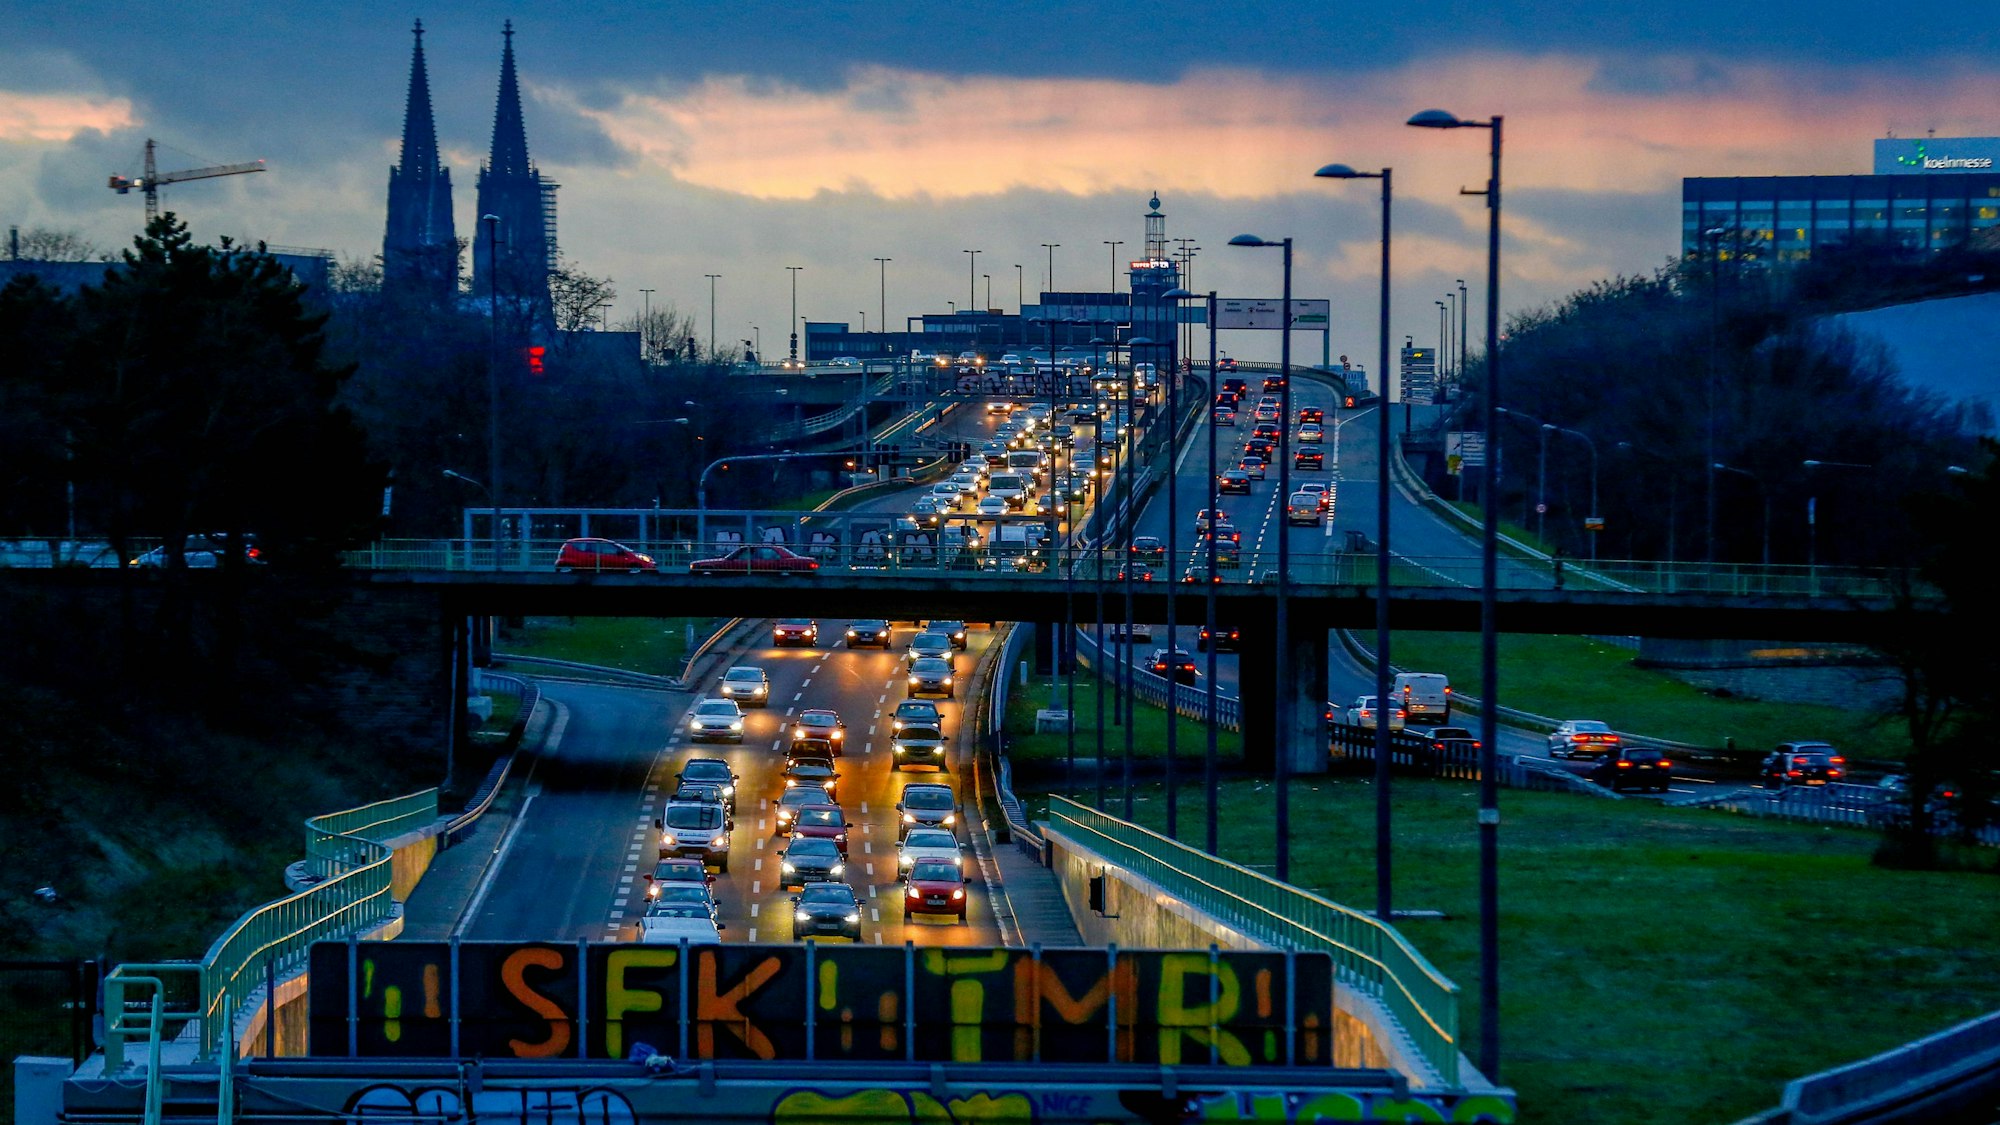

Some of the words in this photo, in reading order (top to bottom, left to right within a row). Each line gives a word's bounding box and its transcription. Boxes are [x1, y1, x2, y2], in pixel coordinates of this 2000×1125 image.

[1923, 155, 1992, 169] koelnmesse
[502, 947, 781, 1060] SFK
[1042, 1092, 1094, 1115] NICE
